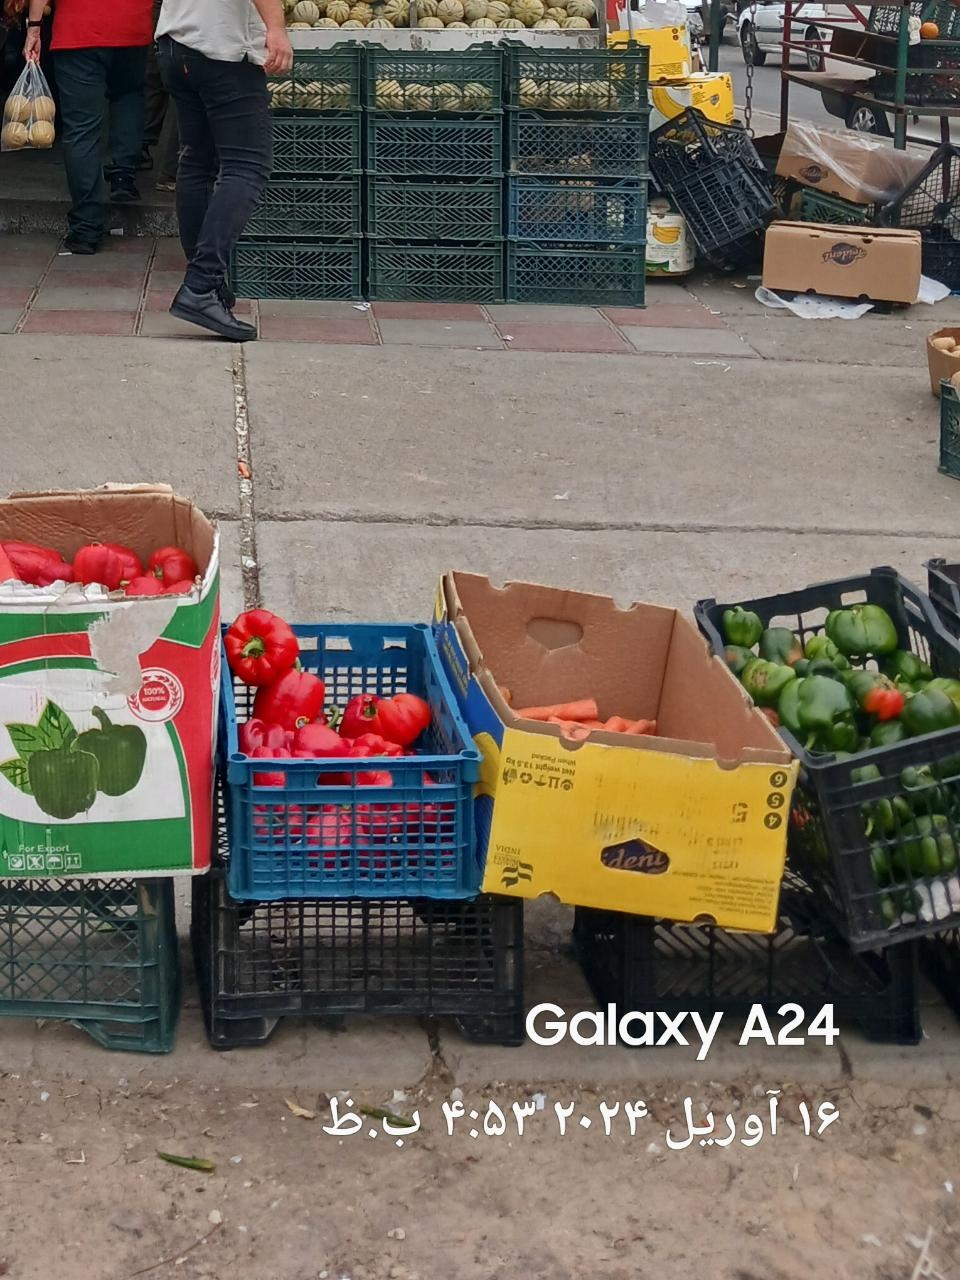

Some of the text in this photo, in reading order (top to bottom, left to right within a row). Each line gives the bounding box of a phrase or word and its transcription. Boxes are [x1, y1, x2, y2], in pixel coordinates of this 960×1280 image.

[143, 686, 166, 696] 100%
[506, 756, 516, 767] kg
[535, 764, 561, 773] weight
[561, 768, 576, 777] Net
[18, 844, 70, 854] For Export
[495, 844, 521, 855] INDIA
